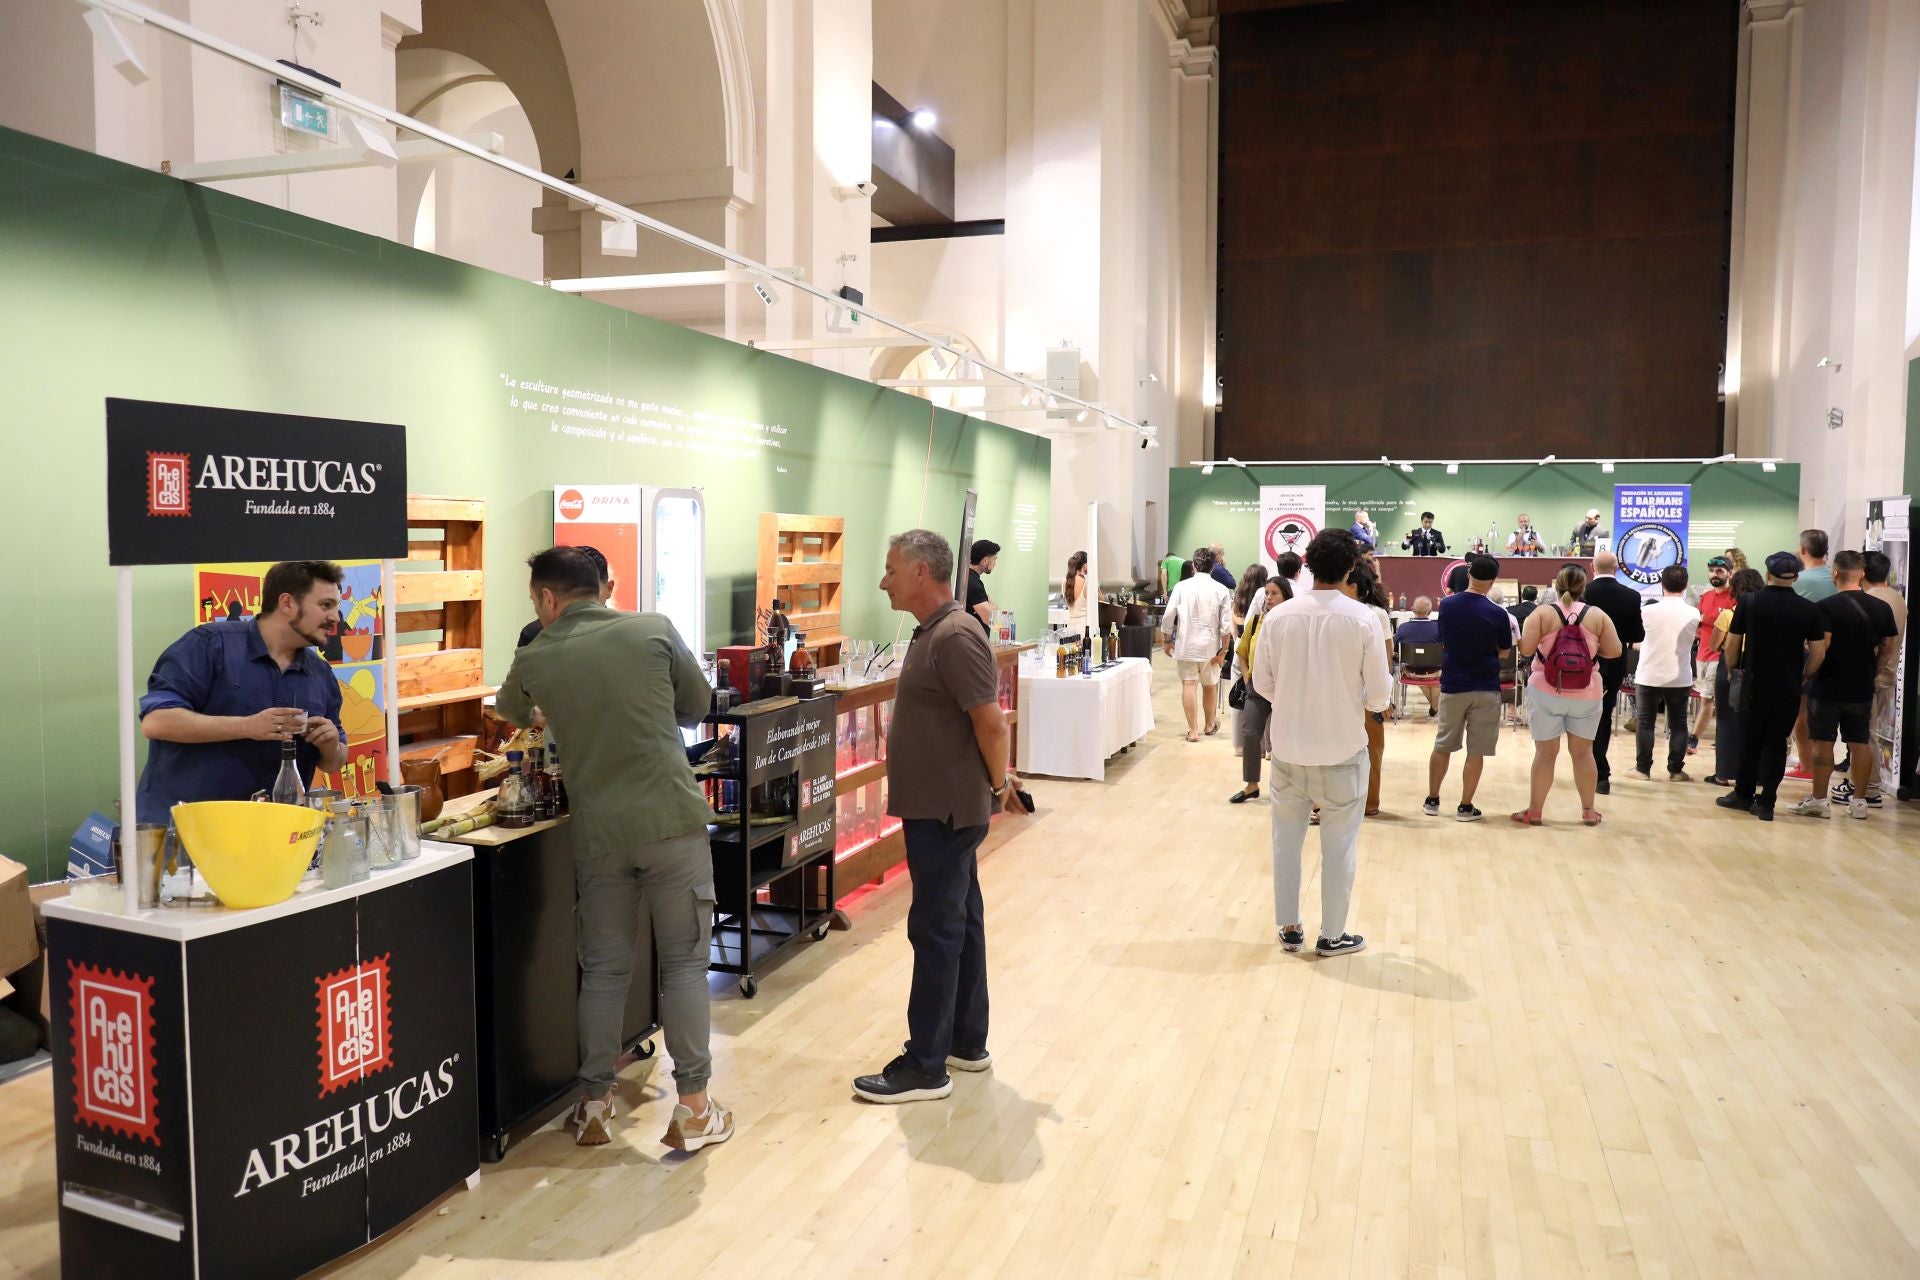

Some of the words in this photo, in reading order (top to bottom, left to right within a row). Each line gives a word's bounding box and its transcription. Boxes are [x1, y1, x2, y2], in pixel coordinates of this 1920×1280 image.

[520, 380, 558, 395] escultura
[562, 388, 613, 404] geometrizada
[616, 398, 625, 406] no
[510, 394, 519, 407] lo
[522, 399, 538, 411] que
[542, 402, 559, 414] creo
[562, 405, 608, 421] conveniente
[551, 420, 558, 431] la
[562, 423, 606, 438] composición
[611, 431, 615, 442] y
[245, 500, 296, 515] Fundada
[299, 505, 311, 515] en
[313, 503, 336, 518] 1884
[592, 496, 631, 505] DRINK
[1621, 497, 1633, 505] DE
[1636, 497, 1683, 506] BARMANS
[1621, 506, 1683, 518] ESPAÑOLES
[768, 749, 777, 765] de
[90, 996, 133, 1044] Are
[93, 1066, 135, 1107] cas
[77, 1134, 122, 1161] Fundada
[124, 1153, 136, 1165] en
[139, 1155, 161, 1175] 1884
[301, 1154, 366, 1197] Fundada
[369, 1147, 383, 1164] en
[387, 1131, 412, 1155] 1884
